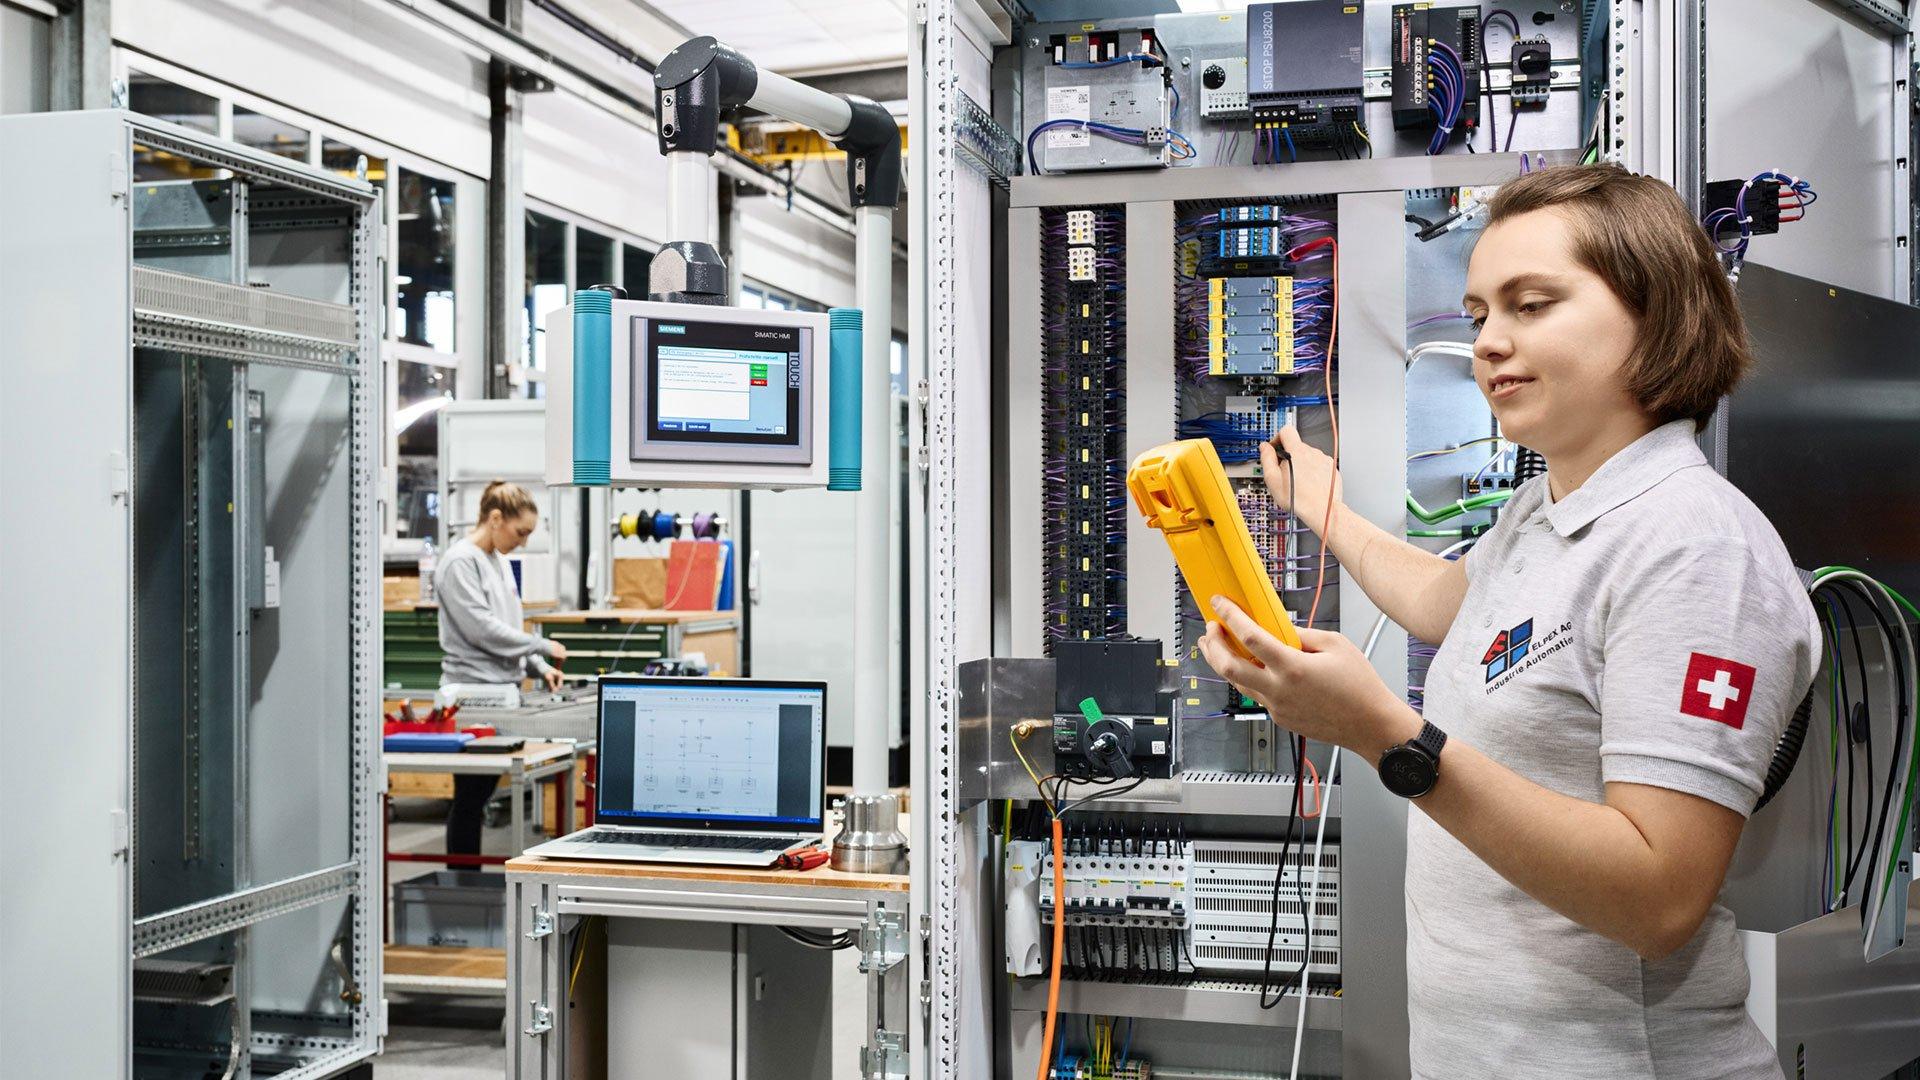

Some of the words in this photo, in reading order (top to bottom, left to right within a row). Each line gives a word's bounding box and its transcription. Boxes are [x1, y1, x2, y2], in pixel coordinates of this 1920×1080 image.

[1263, 10, 1273, 57] PSU8200
[1263, 60, 1273, 90] SITOP
[659, 325, 685, 333] SIEMENS
[754, 331, 778, 339] SIMATIC
[790, 354, 800, 387] TOUCH
[1532, 629, 1559, 651] ELPEX
[1560, 621, 1572, 633] AG
[1486, 666, 1524, 695] Industrie
